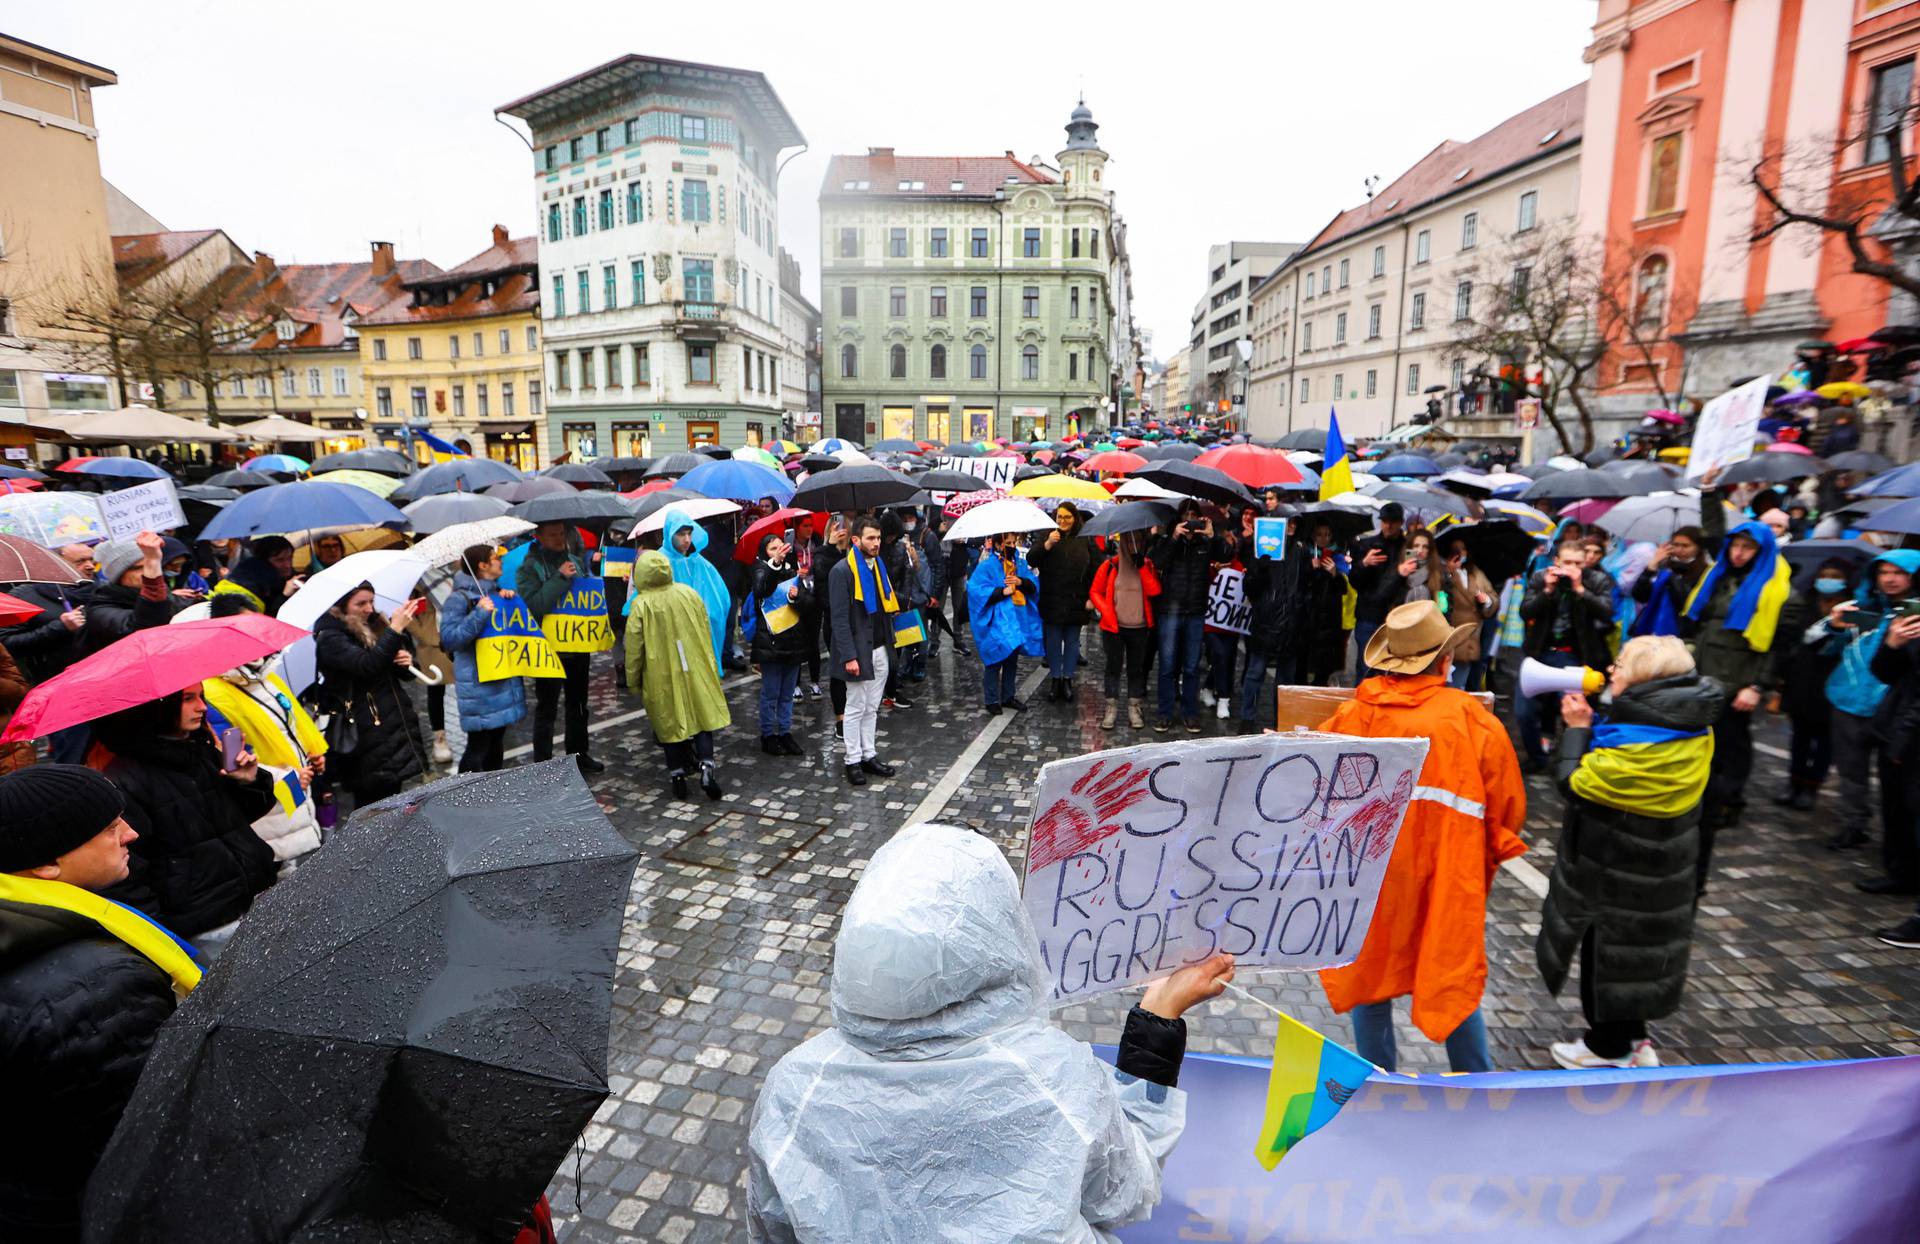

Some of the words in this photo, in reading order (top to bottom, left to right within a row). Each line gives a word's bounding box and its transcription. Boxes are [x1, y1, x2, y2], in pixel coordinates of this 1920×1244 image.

[111, 517, 148, 537] RESIST
[1125, 752, 1379, 838] STOP
[1052, 824, 1373, 928] RUSSIAN
